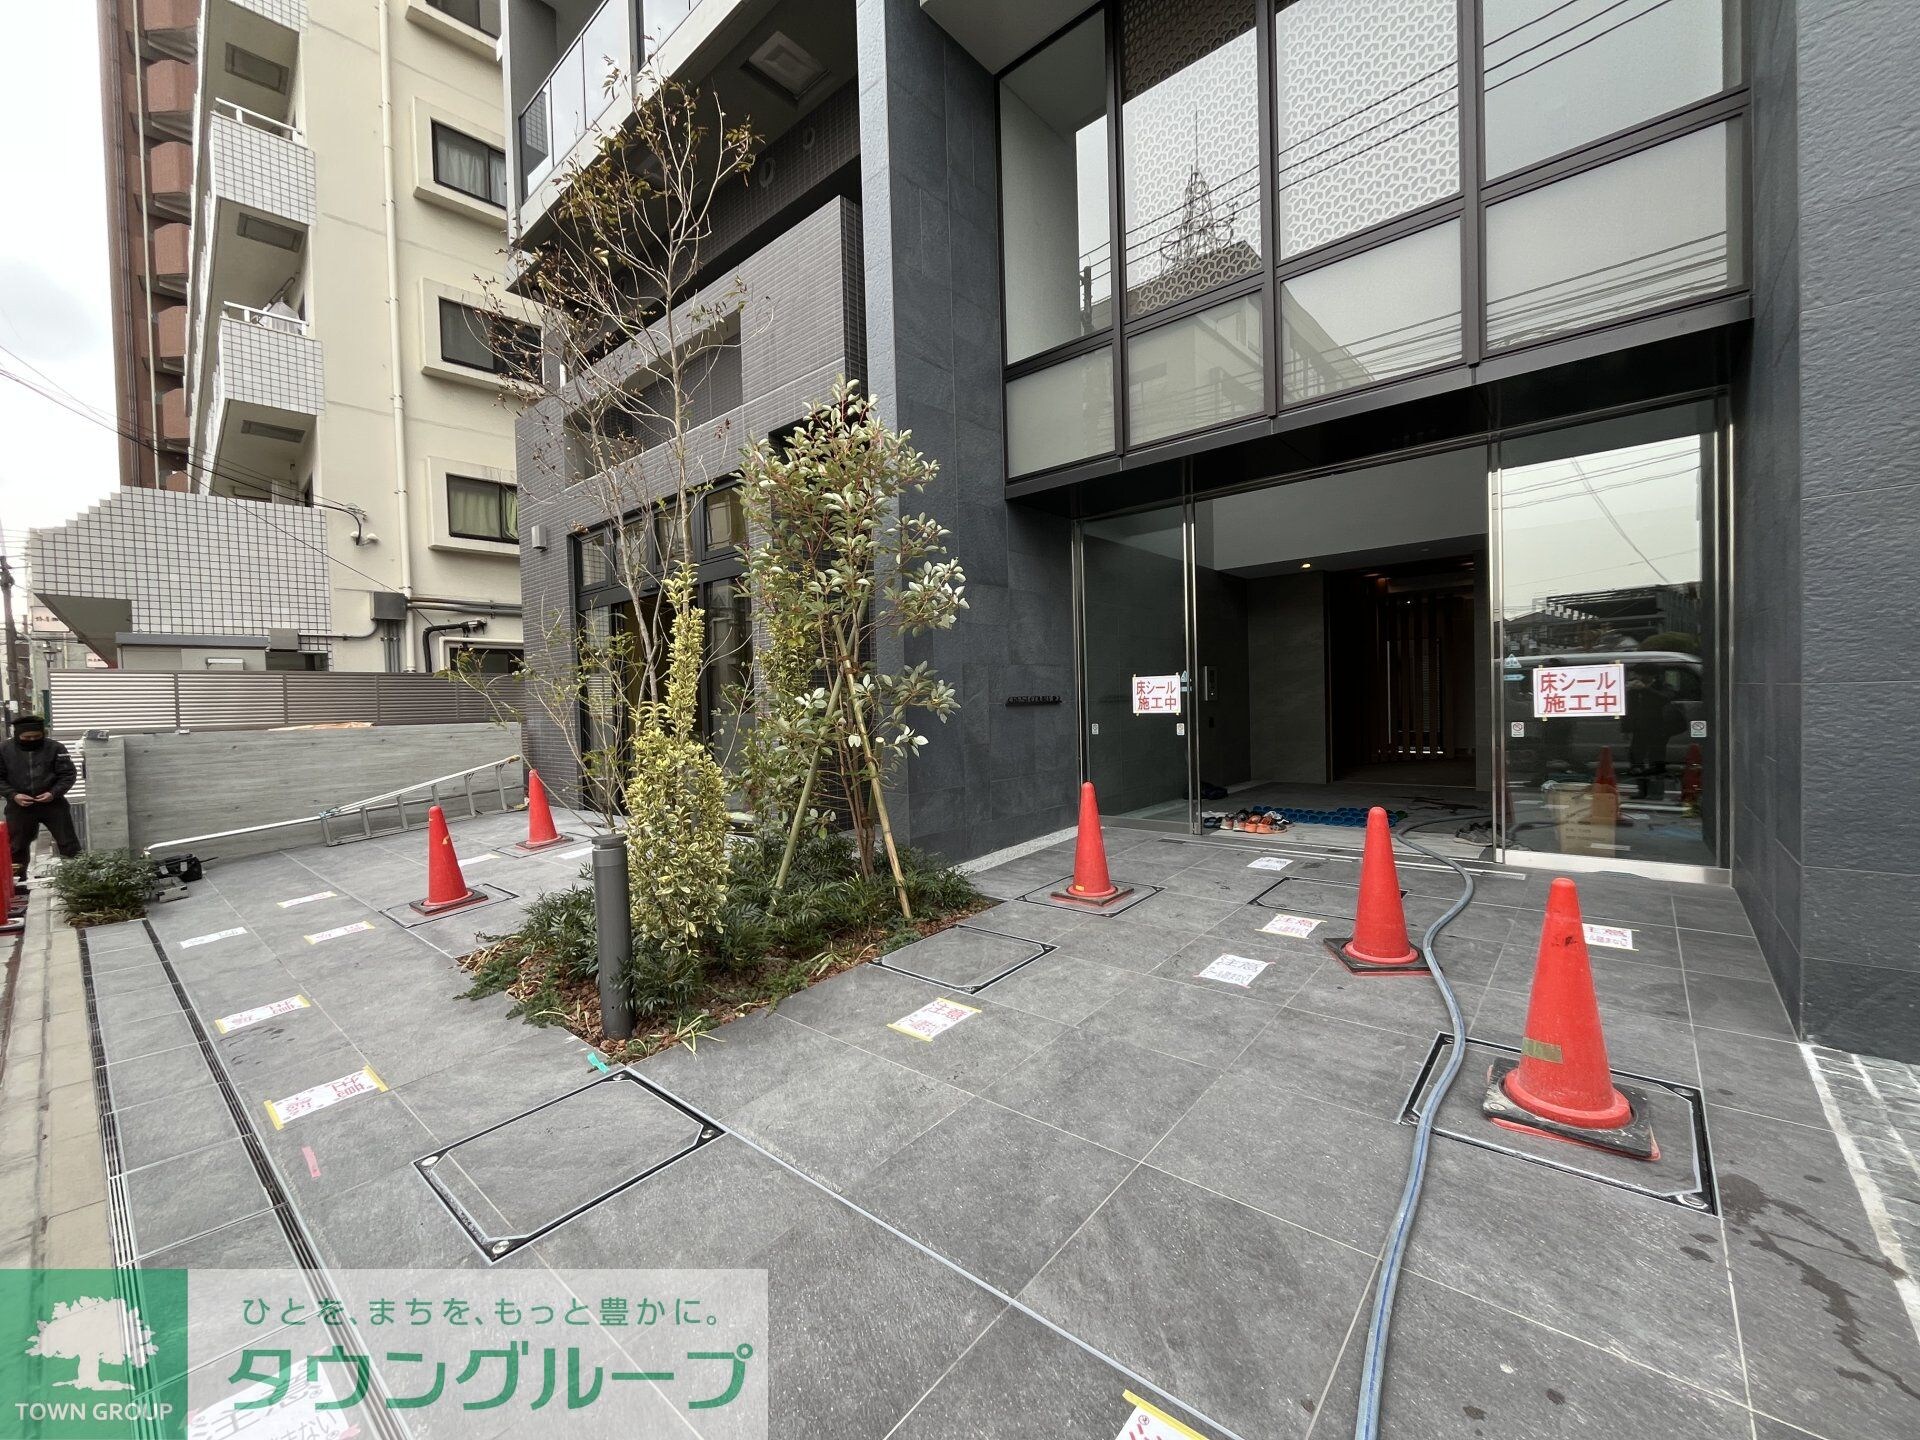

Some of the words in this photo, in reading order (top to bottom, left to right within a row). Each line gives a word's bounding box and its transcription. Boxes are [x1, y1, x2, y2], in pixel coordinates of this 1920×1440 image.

[1136, 680, 1176, 695] 床シール
[1540, 671, 1616, 693] 床シール
[1137, 695, 1177, 710] 施工中
[1543, 691, 1617, 713] 施工中
